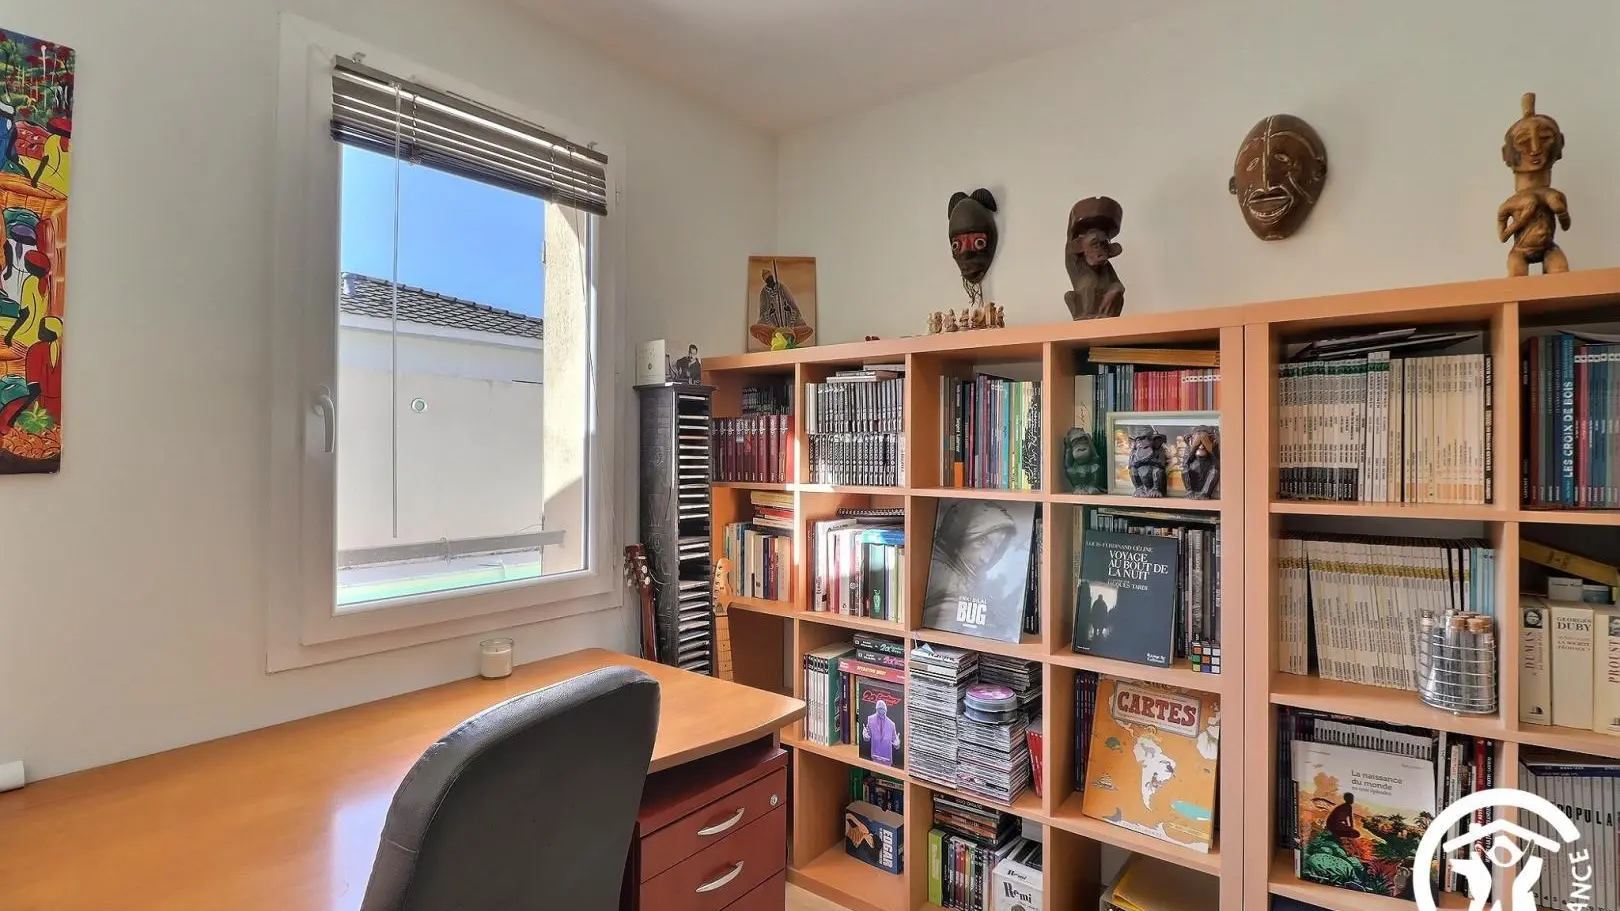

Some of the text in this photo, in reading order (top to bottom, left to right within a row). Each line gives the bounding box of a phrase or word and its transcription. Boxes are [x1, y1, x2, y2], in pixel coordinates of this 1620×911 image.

[1563, 381, 1573, 477] LES CROIX DE BOIS
[1109, 550, 1148, 562] VOYAGE
[1108, 559, 1168, 574] AU BOUT DE
[1108, 567, 1149, 580] LA NUIT
[956, 600, 987, 626] BUG
[1558, 621, 1592, 632] DUBY
[1525, 631, 1535, 669] DUMAS
[1608, 640, 1620, 684] PROUST
[1117, 691, 1197, 727] CARTES
[1351, 770, 1403, 784] La naissance
[1351, 778, 1393, 791] du monde
